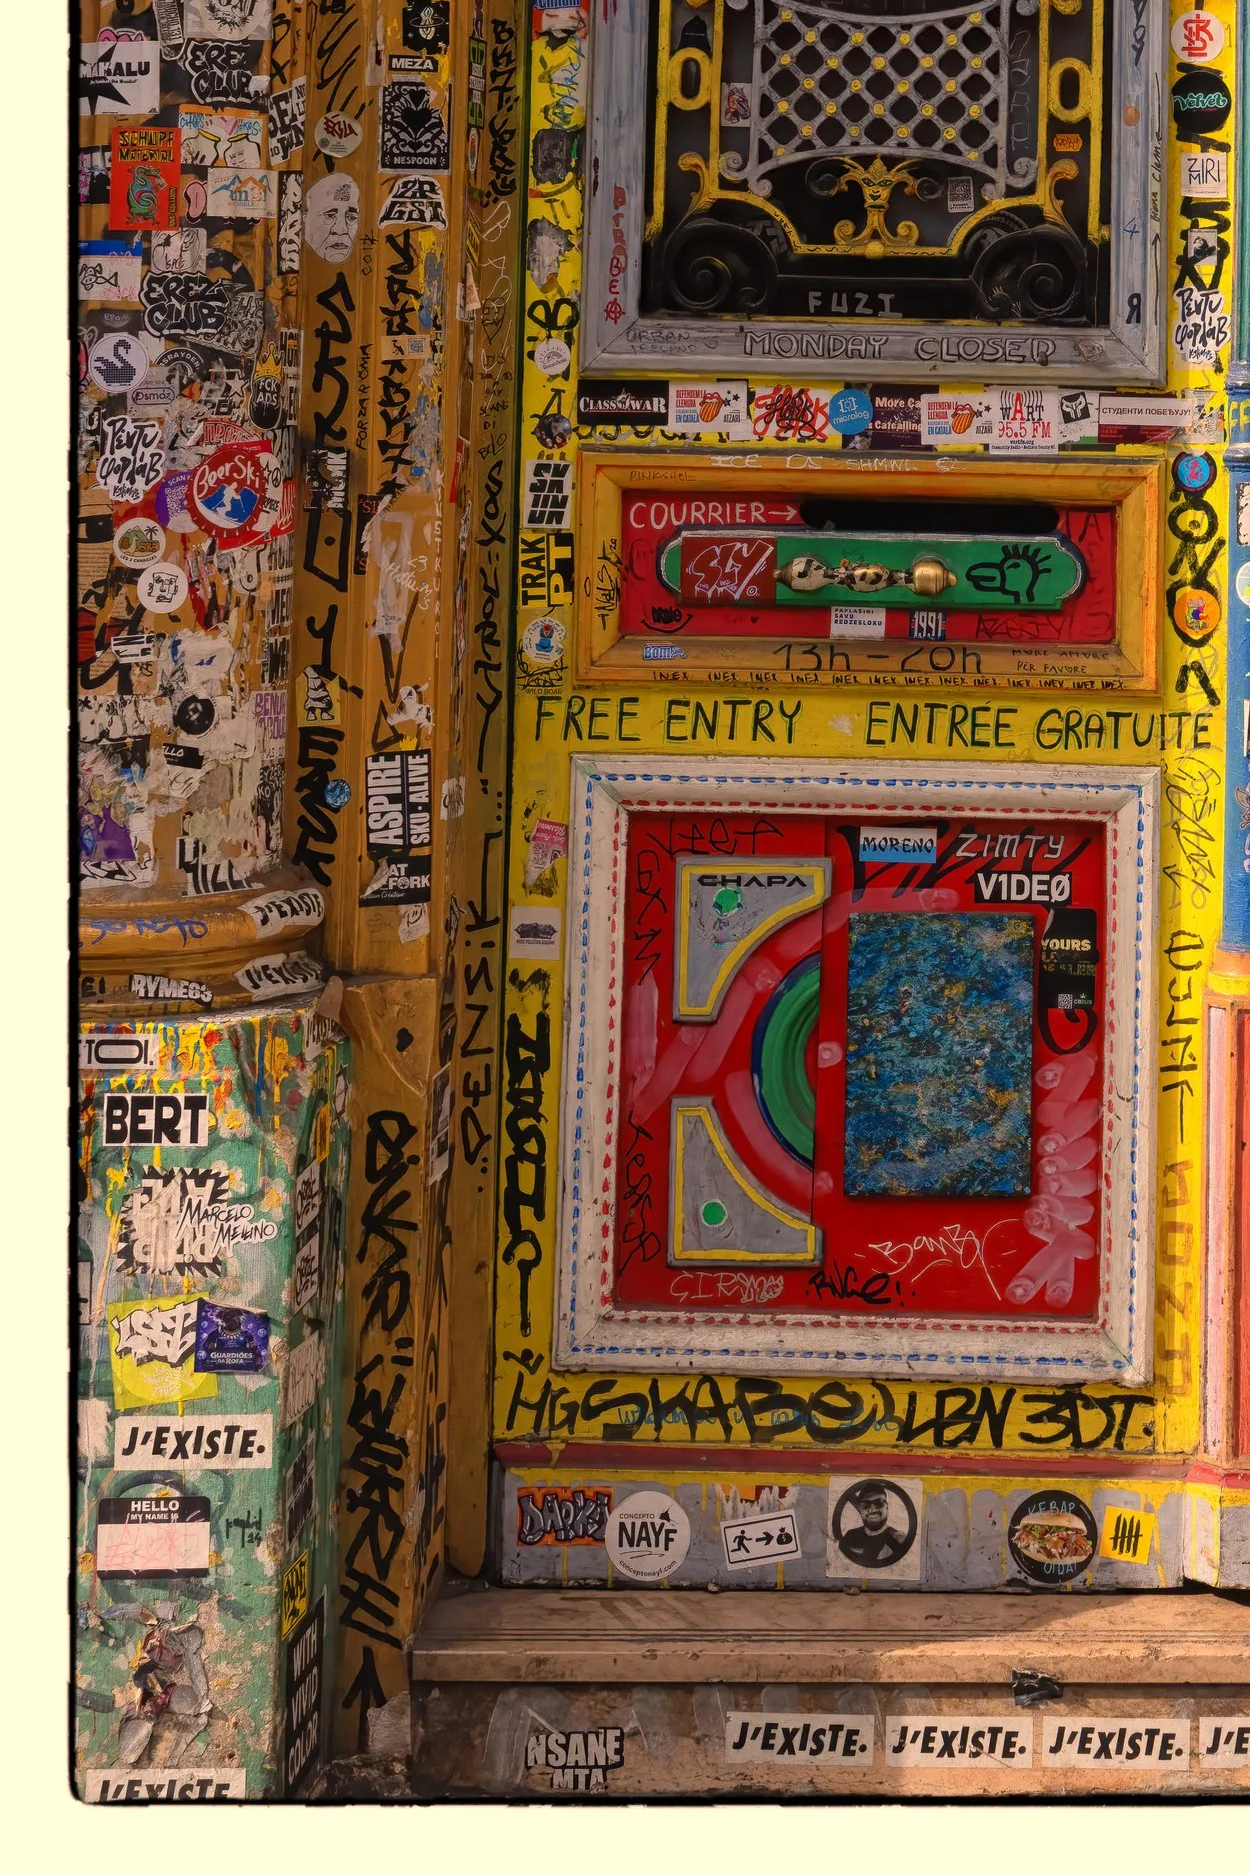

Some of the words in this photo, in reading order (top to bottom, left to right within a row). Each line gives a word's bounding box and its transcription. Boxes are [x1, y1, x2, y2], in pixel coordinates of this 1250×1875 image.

[391, 58, 434, 71] MEZA
[393, 156, 437, 166] NESPOON
[744, 331, 888, 359] MONDAY
[916, 336, 1056, 365] CLOSED
[259, 377, 277, 392] FCK
[256, 392, 278, 406] ADS
[580, 396, 618, 413] CLASS
[631, 398, 667, 413] WAR
[875, 397, 900, 408] More
[833, 410, 870, 424] microlog
[1102, 407, 1143, 416] СТУДЕНТИ
[998, 421, 1028, 439] 95.5
[1032, 421, 1051, 438] FM
[629, 501, 766, 529] COURRIER
[521, 535, 546, 605] TRAK
[773, 643, 851, 672] 13h
[902, 646, 981, 674] 20h
[535, 695, 641, 742] FREE
[667, 700, 802, 744] ENTRY
[865, 701, 1020, 748] ENTRÉE
[1035, 706, 1214, 751] GRATUITE
[368, 754, 401, 846] ASPIRE
[862, 834, 935, 854] MORENO
[697, 875, 808, 888] CHAPA
[1041, 938, 1092, 951] YOURS
[105, 1096, 207, 1145] BERT
[121, 1424, 267, 1461] J'EXISTE.
[130, 1499, 180, 1512] HELLO
[619, 1512, 656, 1520] CONCEPTO
[1027, 1501, 1076, 1518] KEBAP
[618, 1521, 678, 1552] NAYF
[619, 1558, 677, 1577] conceptonayf.com
[292, 1622, 319, 1680] WITH
[291, 1681, 319, 1723] VIVID
[732, 1721, 868, 1758] J'EXISTE.
[892, 1725, 1027, 1759] J'EXISTE.
[1049, 1725, 1184, 1761] J'EXISTE.
[287, 1725, 319, 1785] COLOR
